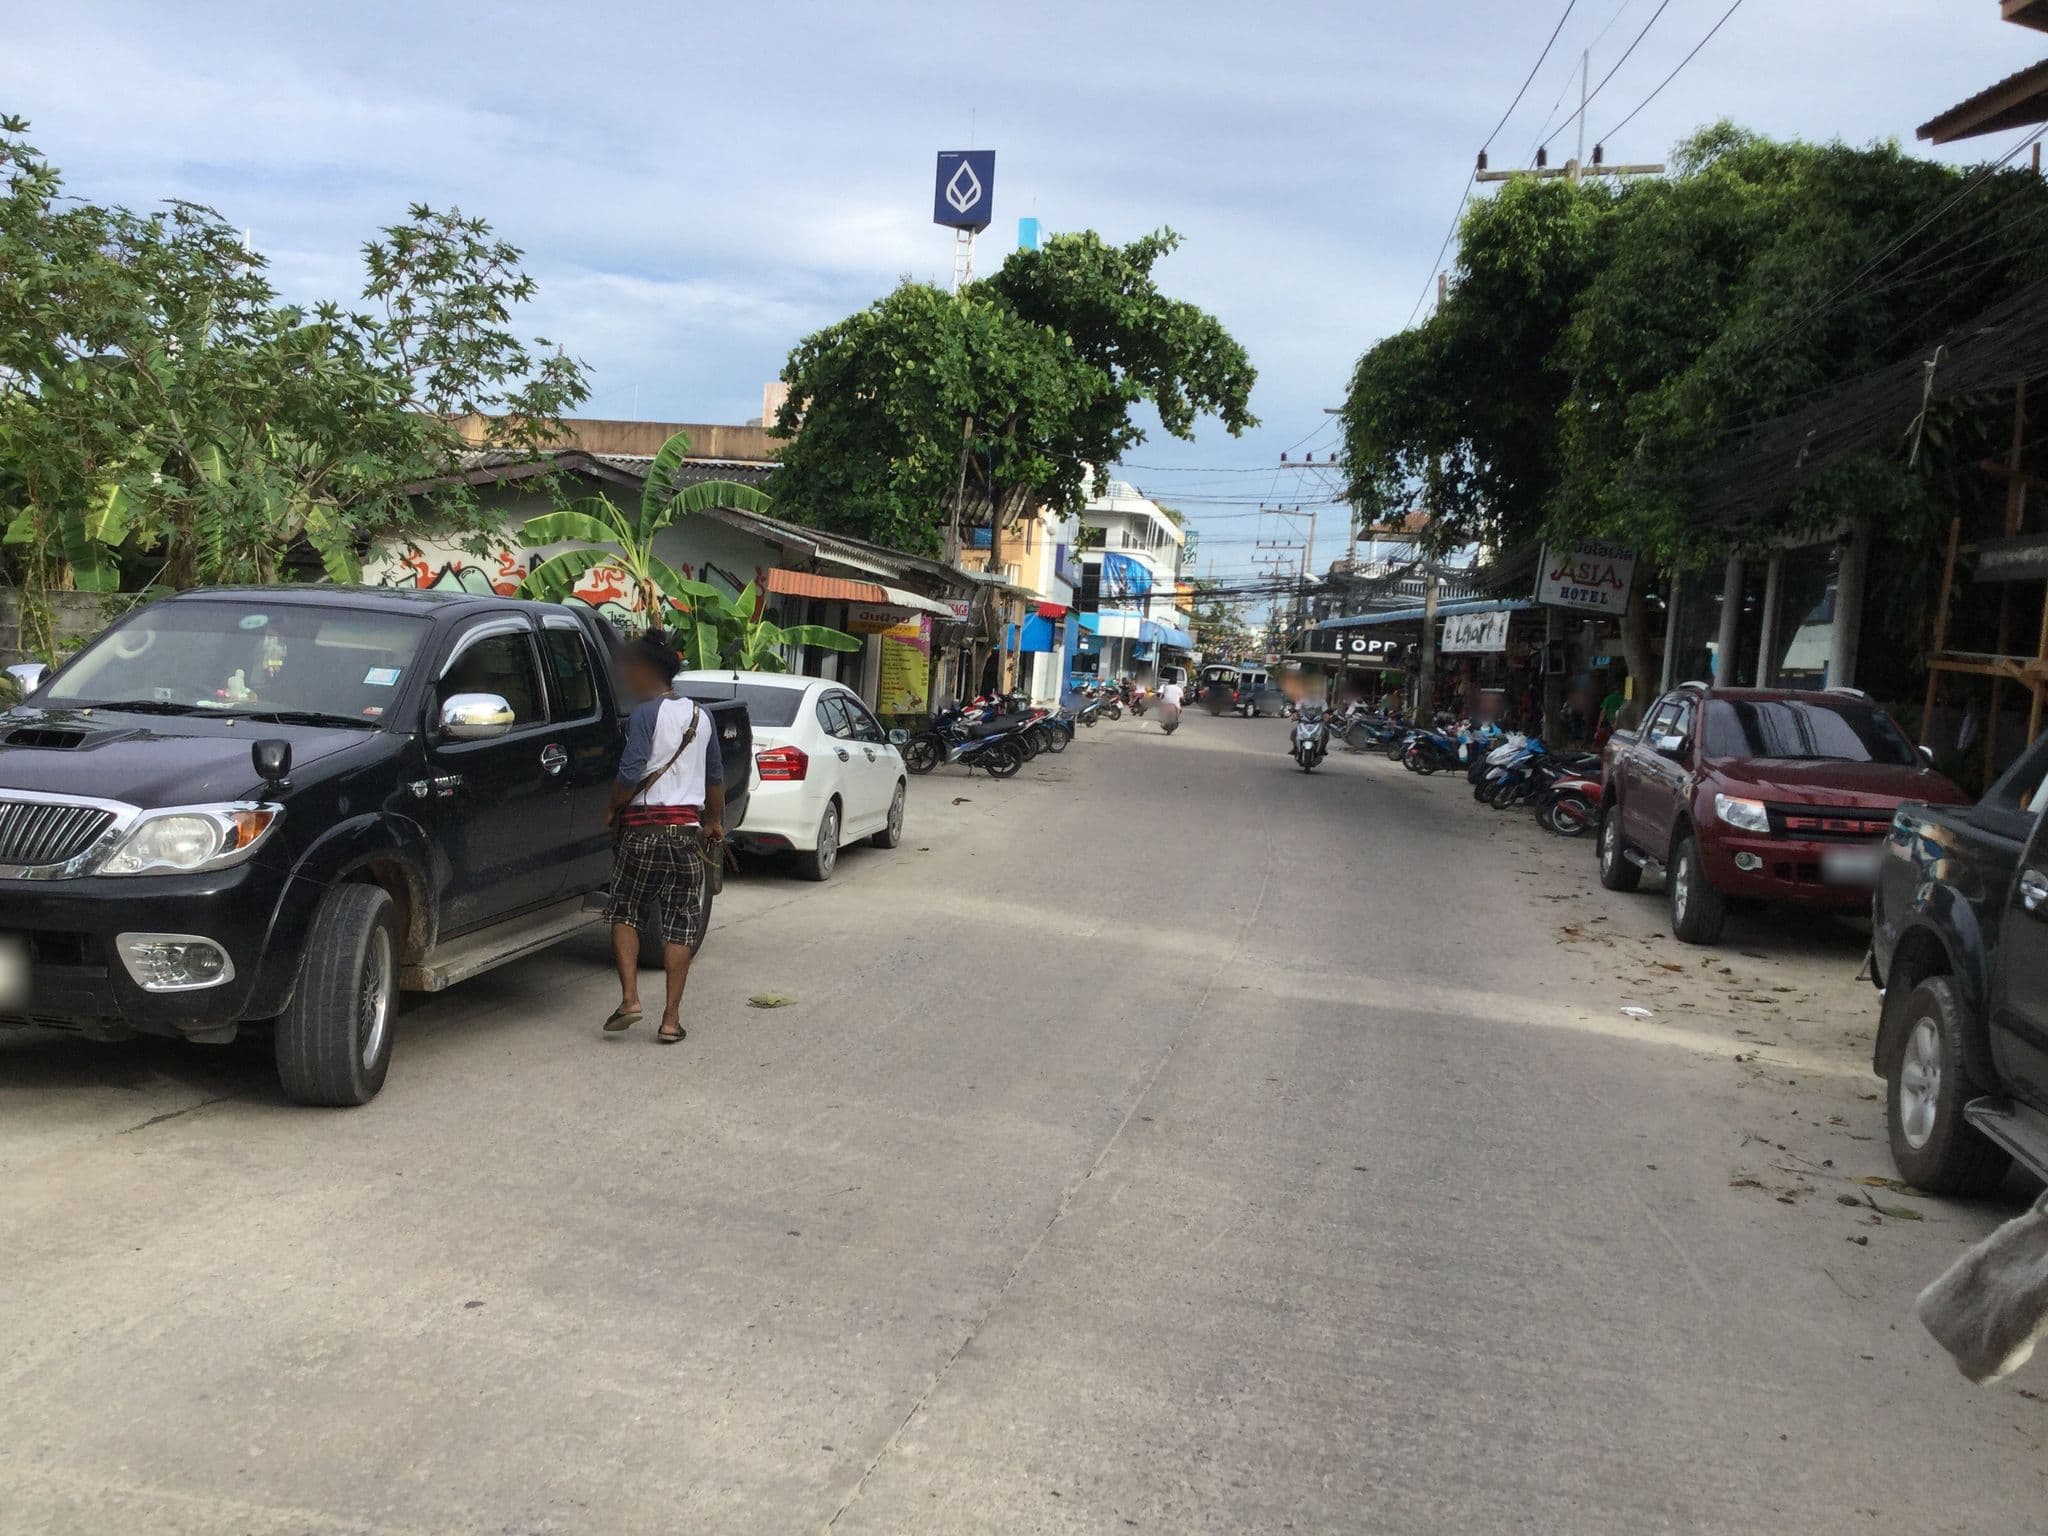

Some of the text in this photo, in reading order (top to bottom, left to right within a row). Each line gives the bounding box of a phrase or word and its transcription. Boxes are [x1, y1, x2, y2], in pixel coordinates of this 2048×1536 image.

[1550, 561, 1624, 589] ASIA
[1560, 586, 1608, 604] HOTEL
[1785, 816, 1892, 833] FOR
